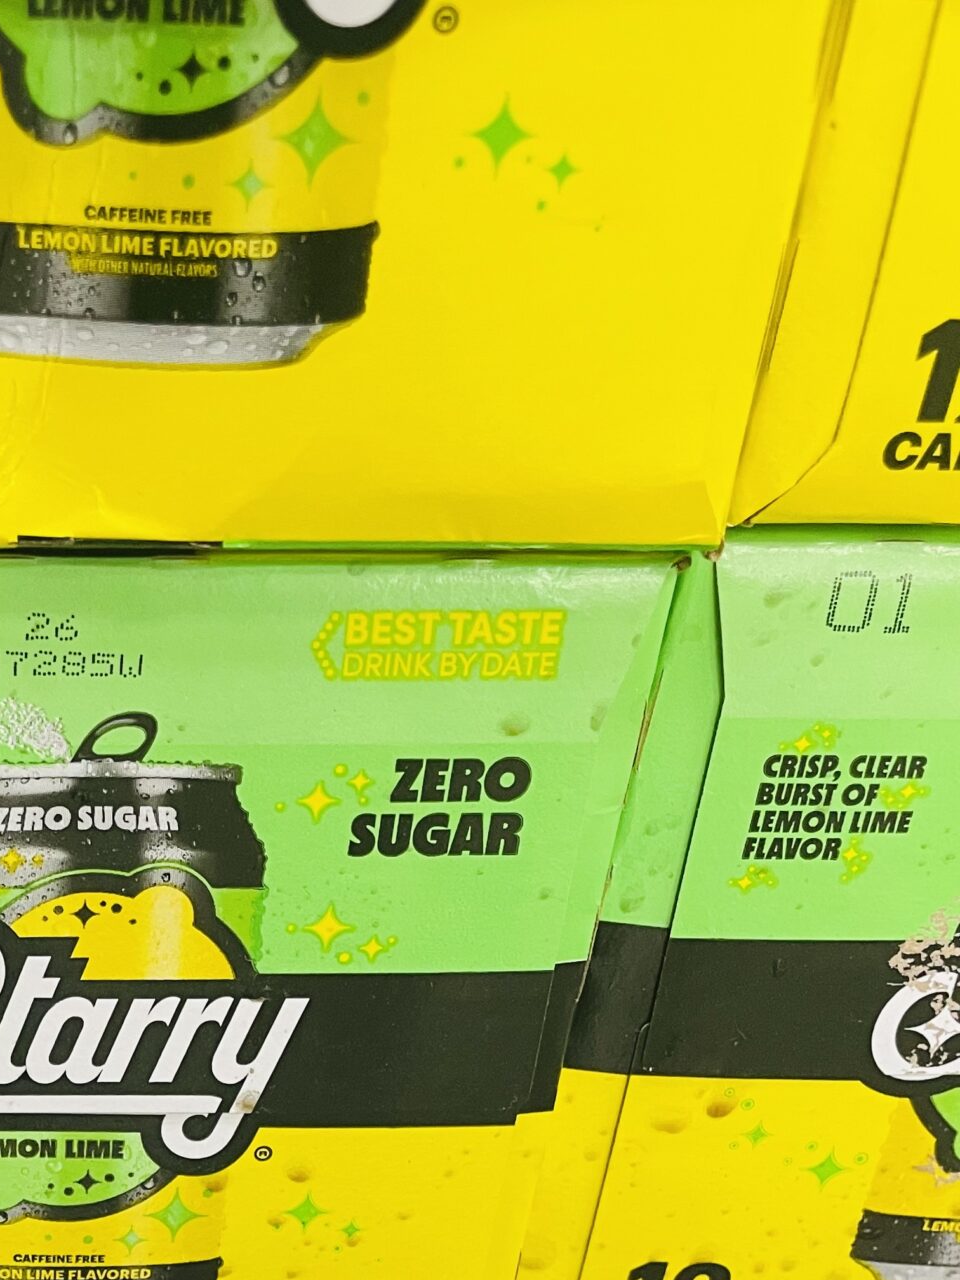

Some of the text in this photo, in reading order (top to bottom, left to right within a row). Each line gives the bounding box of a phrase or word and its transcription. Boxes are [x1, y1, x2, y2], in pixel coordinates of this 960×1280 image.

[84, 204, 212, 226] CAFFEINE FREE
[17, 225, 278, 259] LEMON LIME FLAVORED
[915, 318, 960, 424] 1
[882, 431, 960, 471] CA
[826, 570, 913, 635] 01
[25, 612, 78, 641] 26
[344, 611, 564, 646] BEST TASTE
[342, 652, 558, 678] DRINK BY DATE
[390, 757, 532, 802] ZERO
[763, 754, 928, 782] CRISP, CLEAR
[755, 782, 881, 807] BURST OF
[77, 806, 180, 832] SUGAR
[748, 810, 914, 834] LEMON LIME
[347, 812, 524, 857] SUGAR
[741, 837, 843, 861] FLAVOR
[64, 1139, 126, 1160] LIME
[13, 1253, 106, 1264] CAFFEINE FREE
[26, 1268, 65, 1280] LIME
[67, 1268, 152, 1280] FLAVORED
